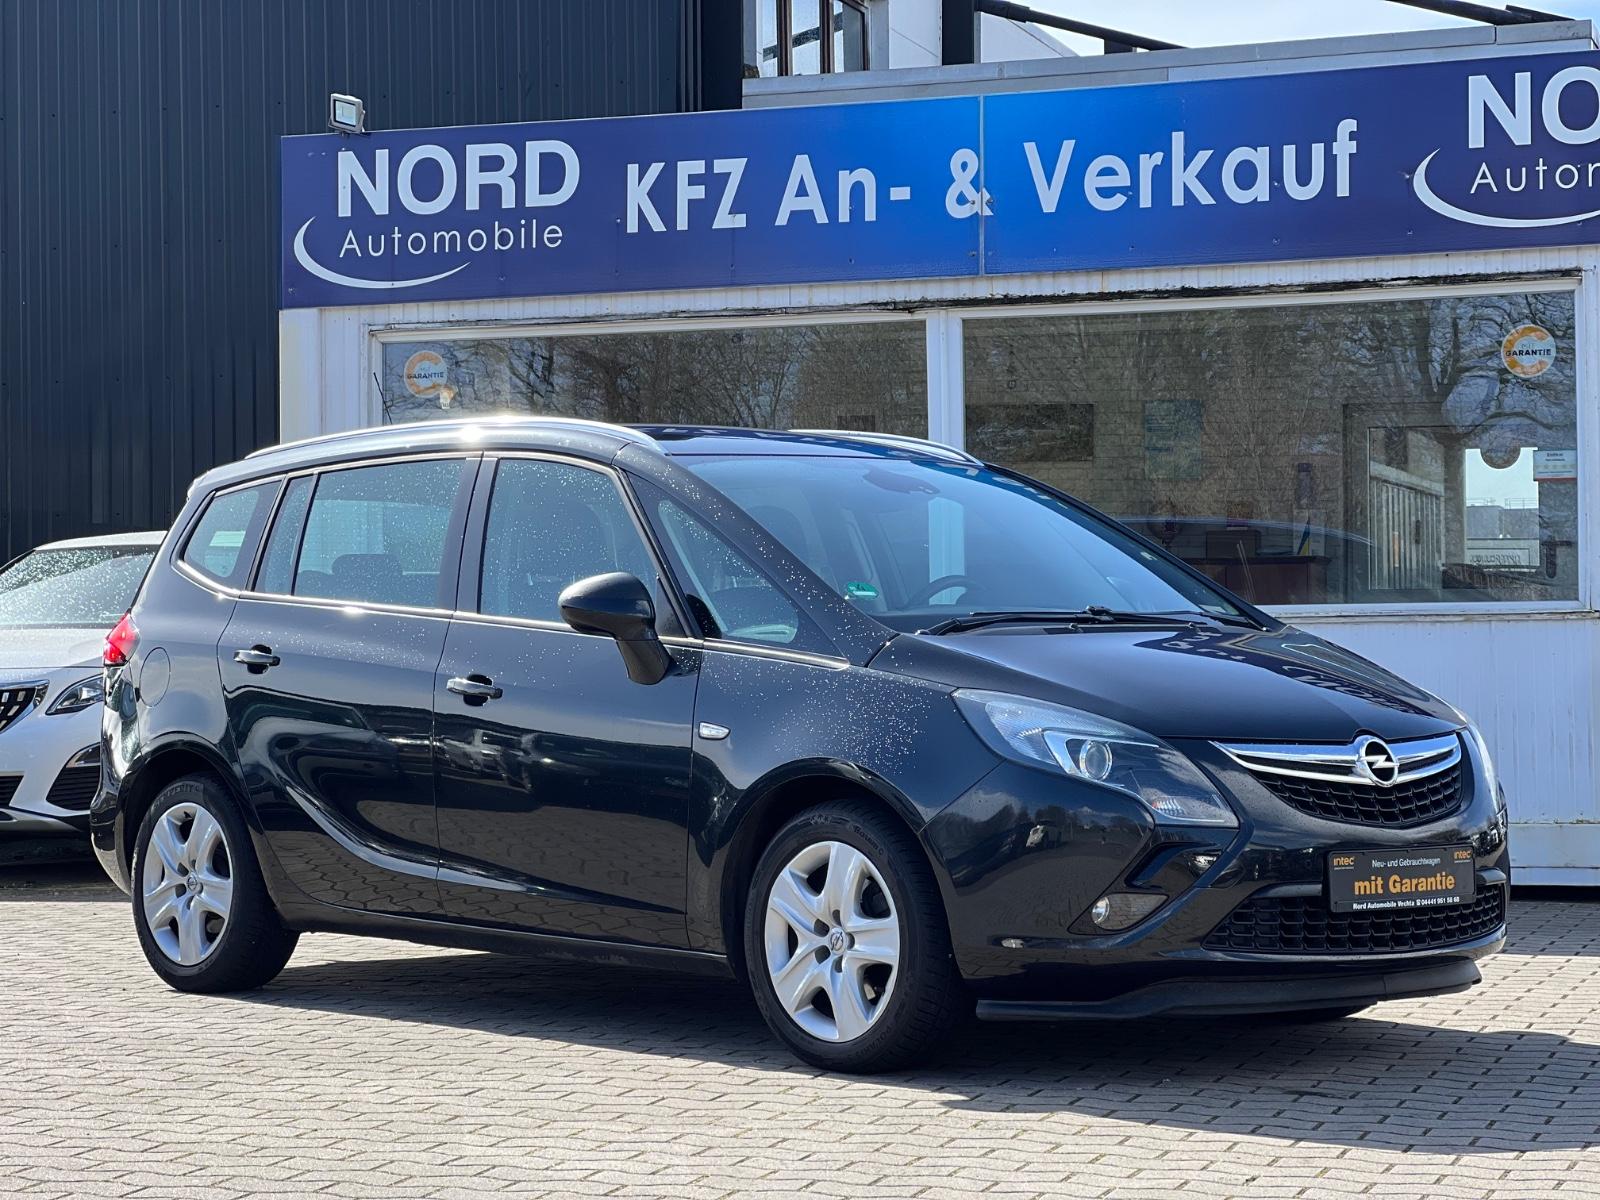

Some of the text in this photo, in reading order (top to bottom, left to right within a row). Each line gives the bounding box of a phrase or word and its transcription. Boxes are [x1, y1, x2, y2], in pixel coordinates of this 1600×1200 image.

[337, 139, 580, 218] NORD
[626, 118, 1358, 234] KFZ An- & Verkauf
[339, 219, 563, 258] Automobile
[1505, 348, 1552, 356] GARANTIE
[1387, 858, 1398, 867] und
[1354, 871, 1455, 895] mit Garantie
[1352, 902, 1366, 910] Nord
[1367, 900, 1397, 909] Automobile
